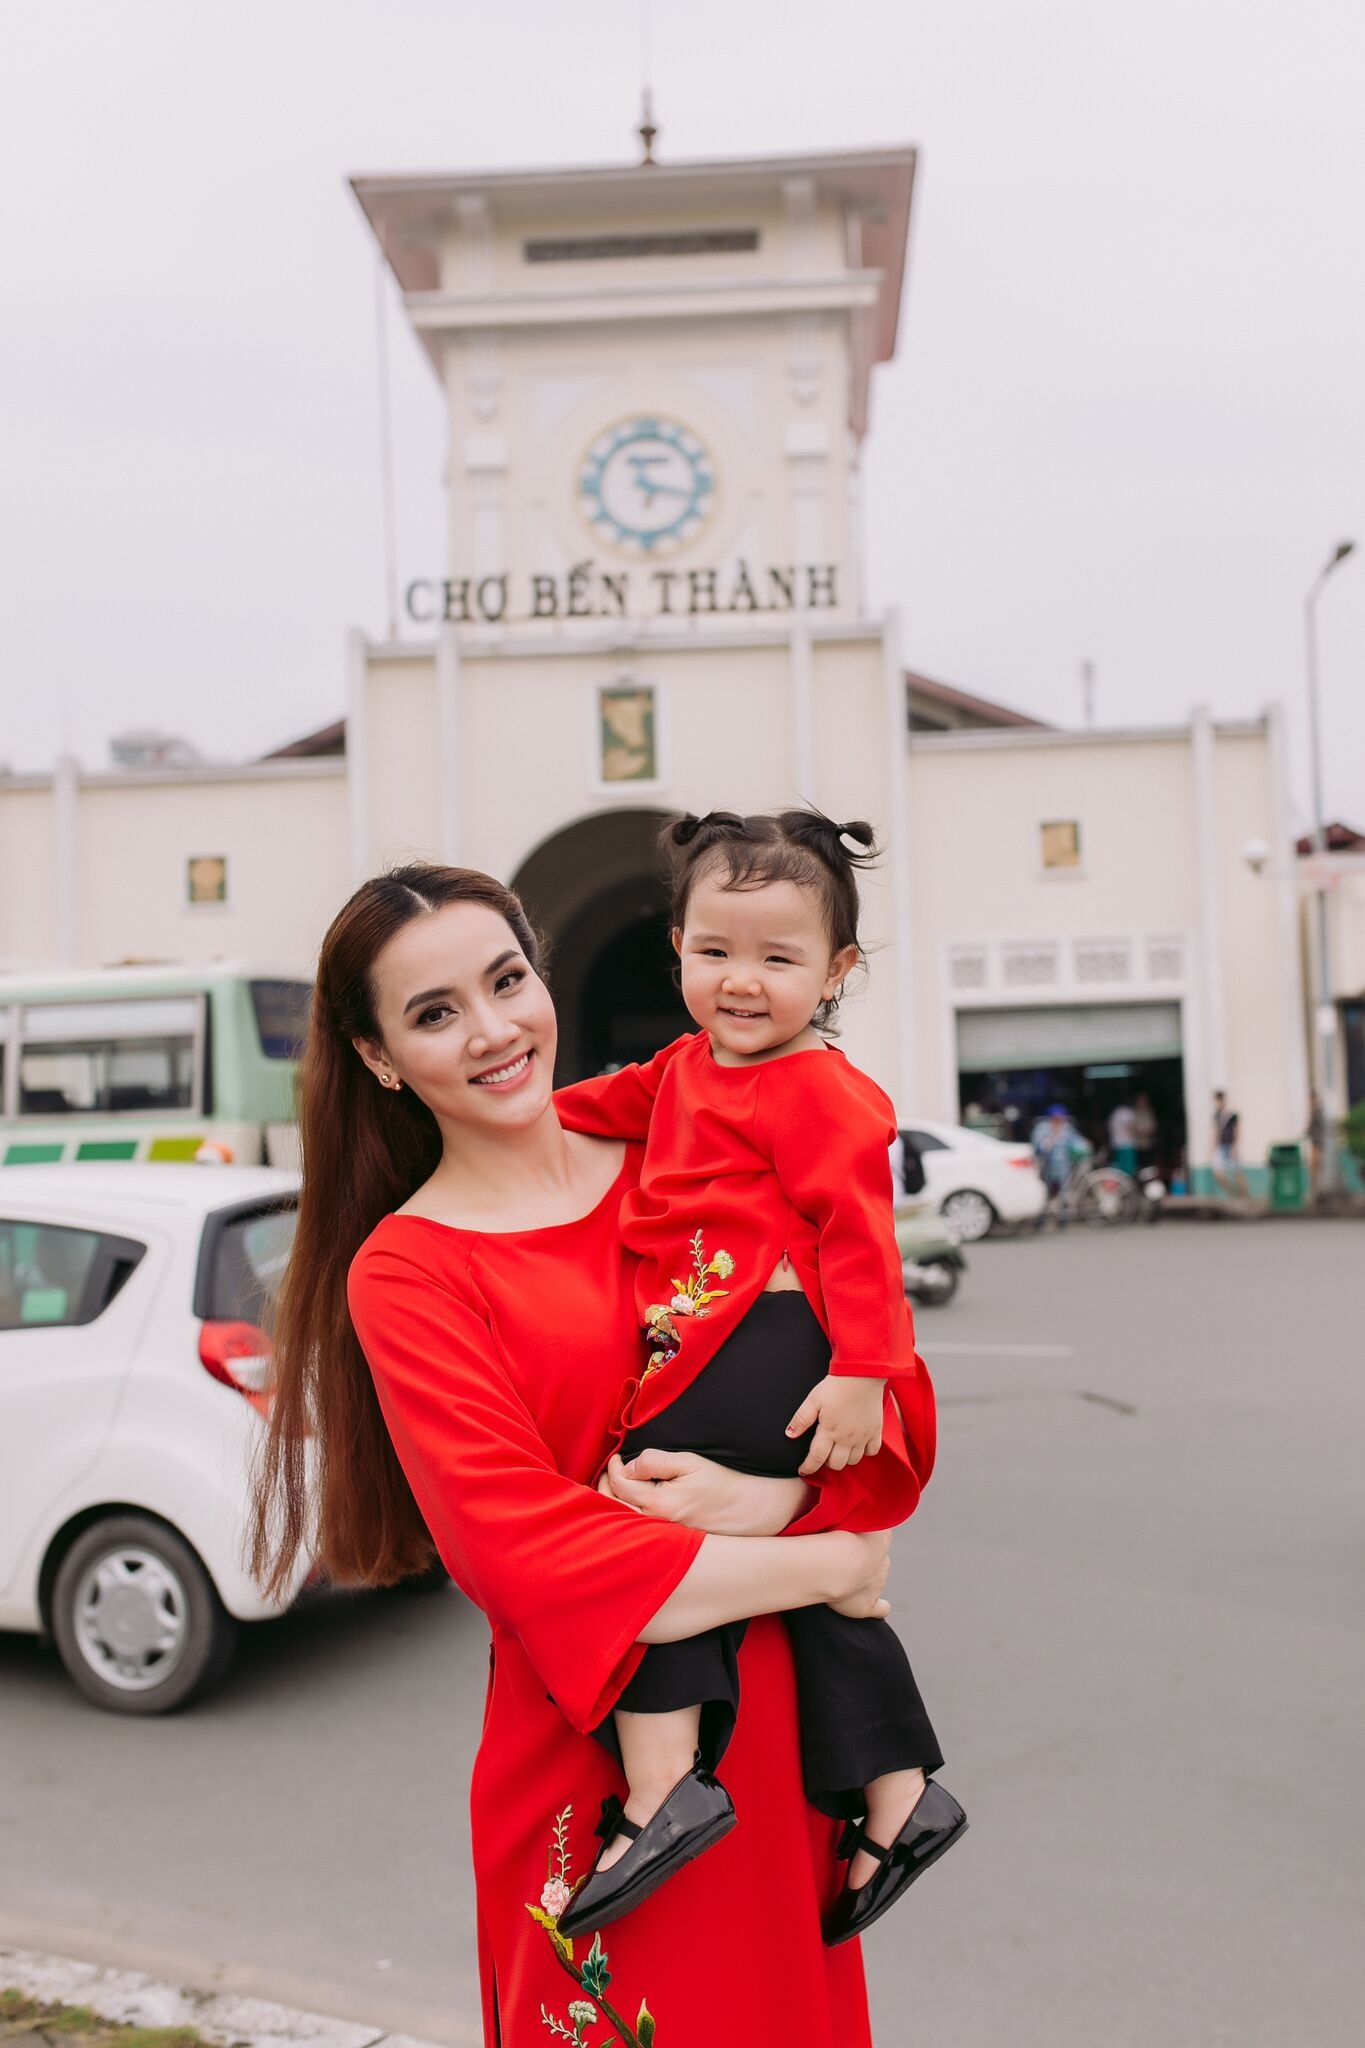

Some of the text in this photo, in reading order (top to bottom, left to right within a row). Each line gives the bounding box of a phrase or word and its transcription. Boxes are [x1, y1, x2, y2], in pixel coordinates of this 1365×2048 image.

[406, 558, 838, 622] CHỢ BẾN THÀNH
